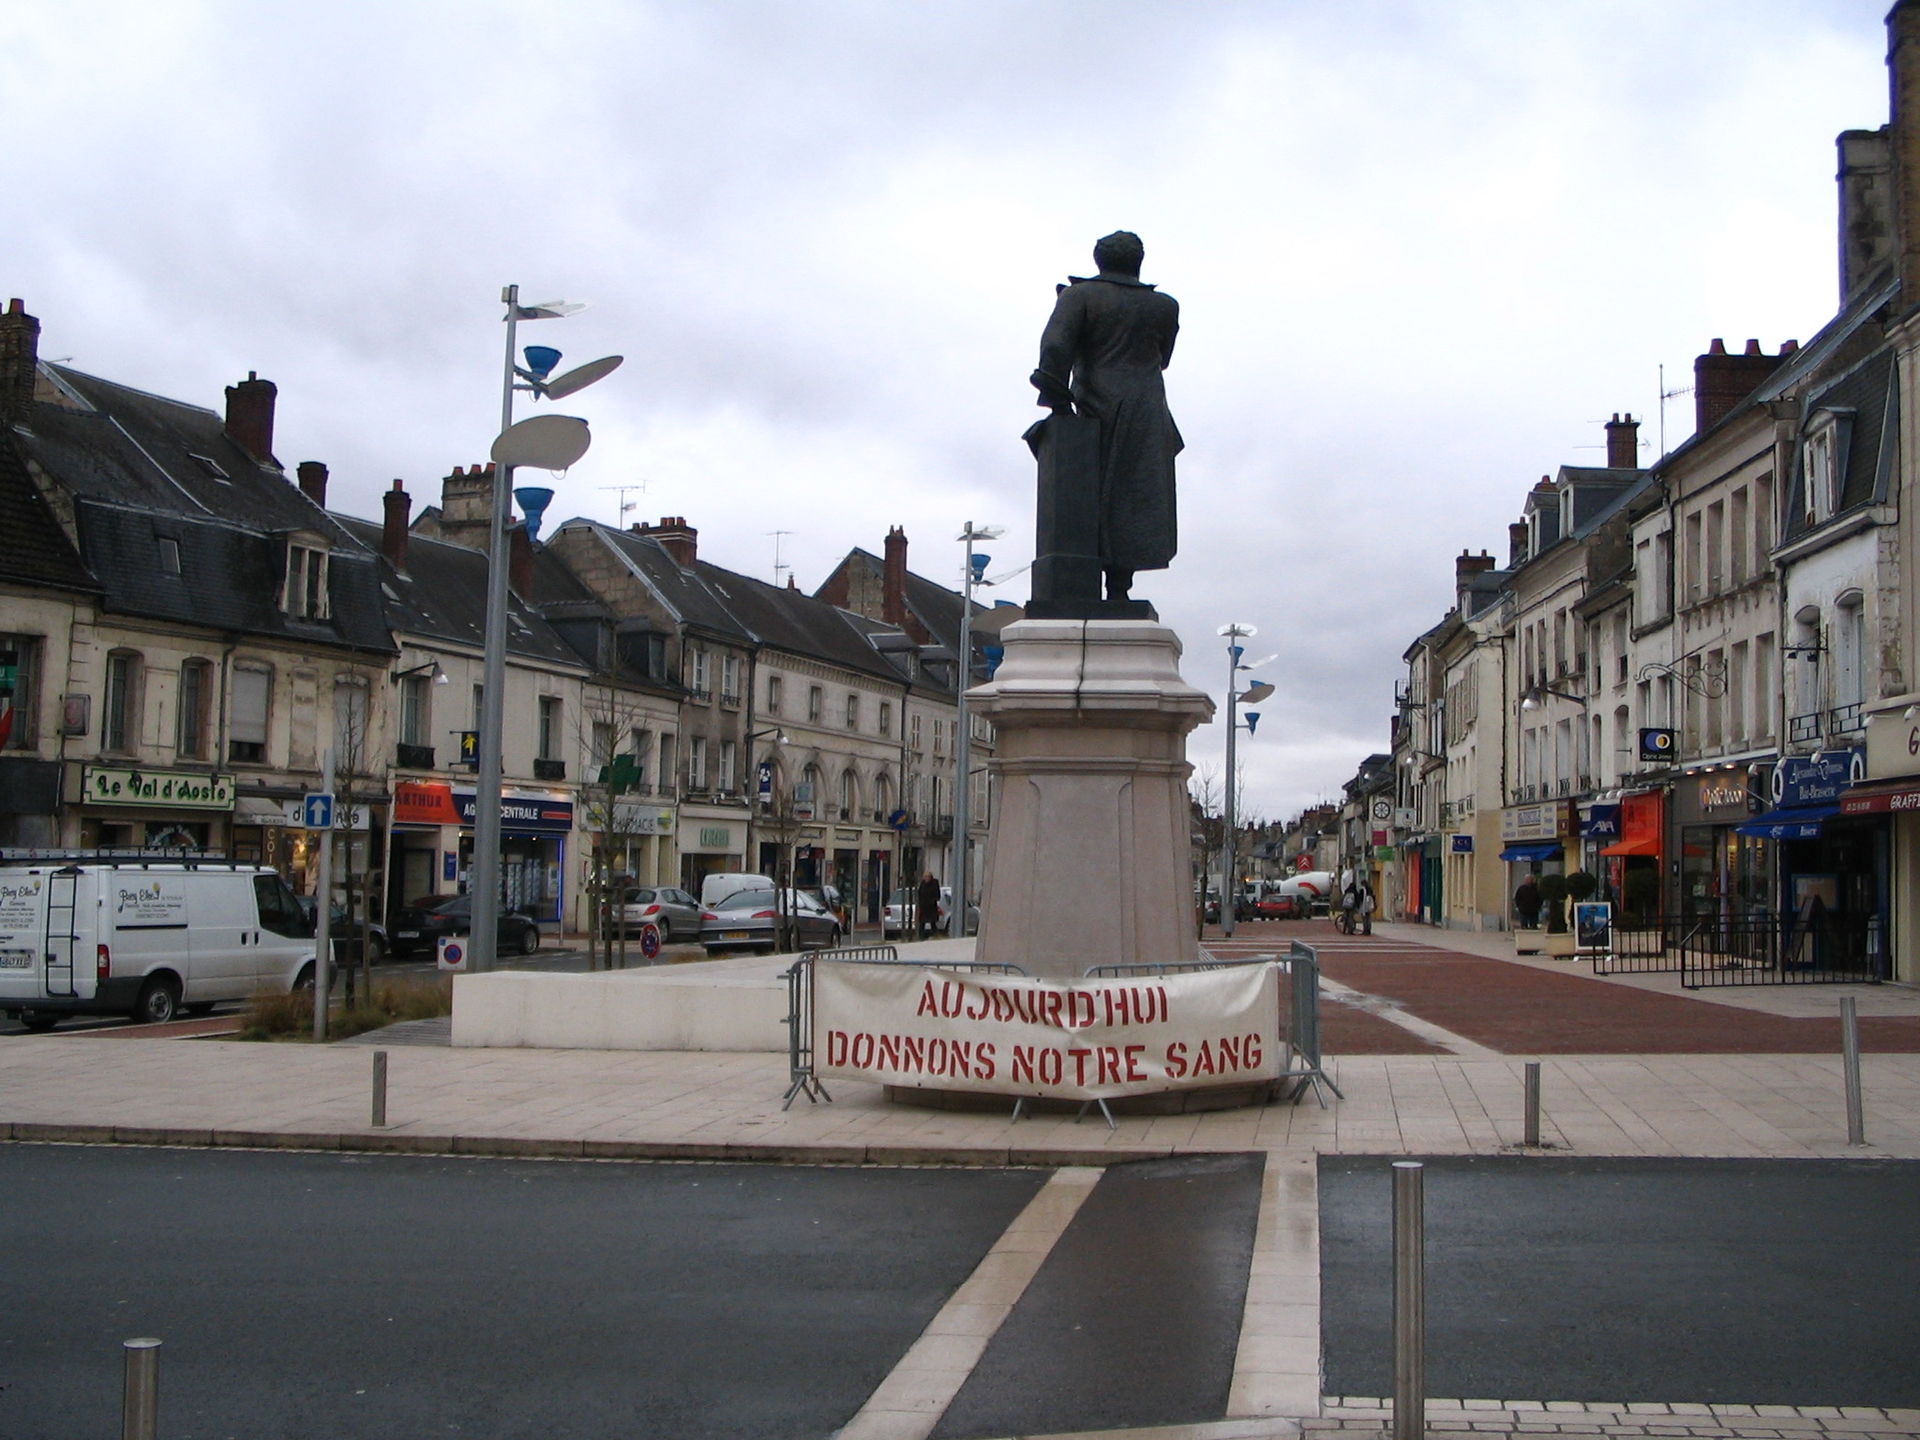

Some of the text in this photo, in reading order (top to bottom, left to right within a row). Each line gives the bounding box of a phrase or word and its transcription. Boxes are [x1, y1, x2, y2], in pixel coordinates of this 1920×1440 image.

[97, 773, 226, 801] Le Val d'Aoste
[1591, 820, 1615, 833] AXA
[917, 980, 1168, 1028] AUJOURD'HUI
[827, 1030, 1263, 1086] DONNONS NOTRE SANG
